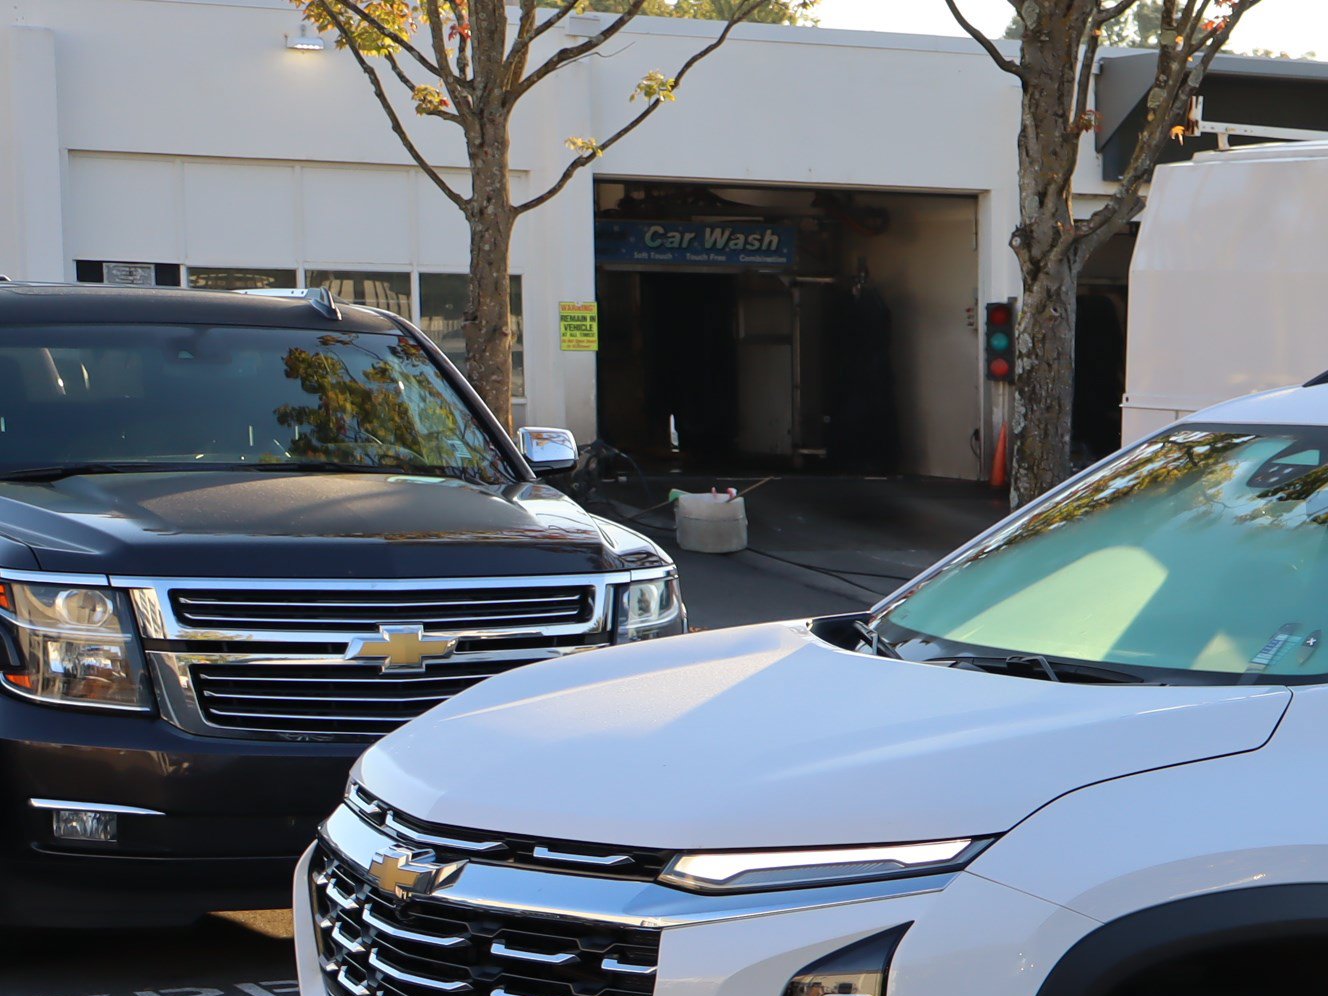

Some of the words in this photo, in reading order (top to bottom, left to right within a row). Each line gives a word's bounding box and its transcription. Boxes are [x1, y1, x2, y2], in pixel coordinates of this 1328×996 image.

[644, 225, 696, 249] Car
[704, 227, 780, 251] Wash
[650, 252, 673, 260] Touch
[686, 252, 708, 261] Touch
[739, 254, 787, 263] Combination
[560, 314, 588, 323] REMAIN
[589, 314, 597, 323] IN
[564, 323, 593, 332] VEHICLE
